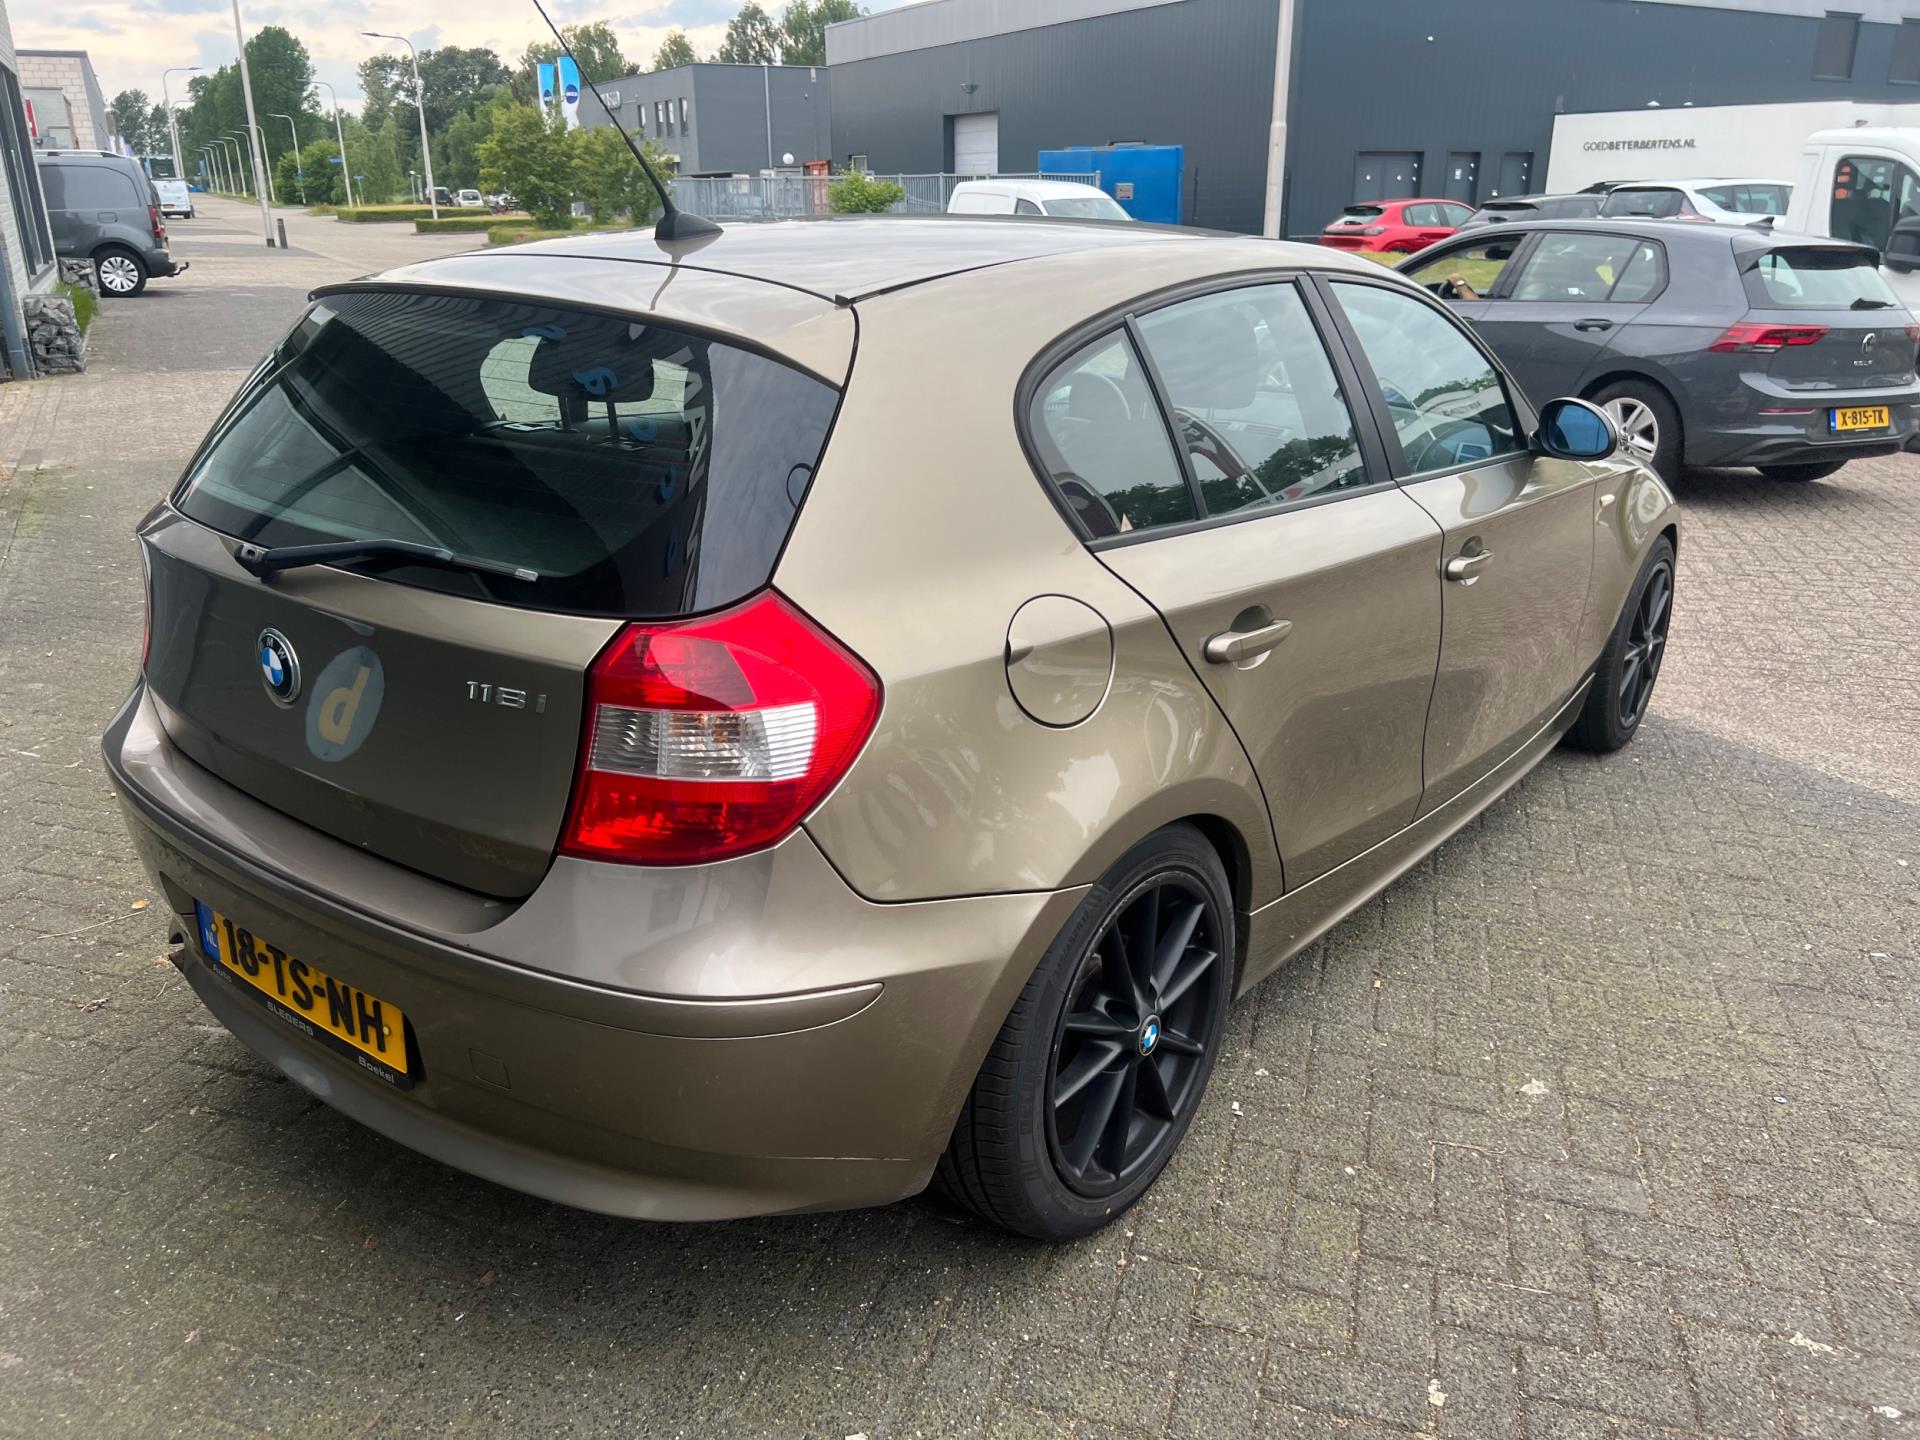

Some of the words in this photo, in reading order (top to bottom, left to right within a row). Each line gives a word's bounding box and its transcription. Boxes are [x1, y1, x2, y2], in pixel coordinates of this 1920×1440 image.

[1583, 139, 1696, 152] GOEDBETERBERTENS.NL
[1841, 409, 1884, 427] X-815-TK
[204, 927, 218, 948] NL
[222, 917, 387, 1053] 18-TS-NH
